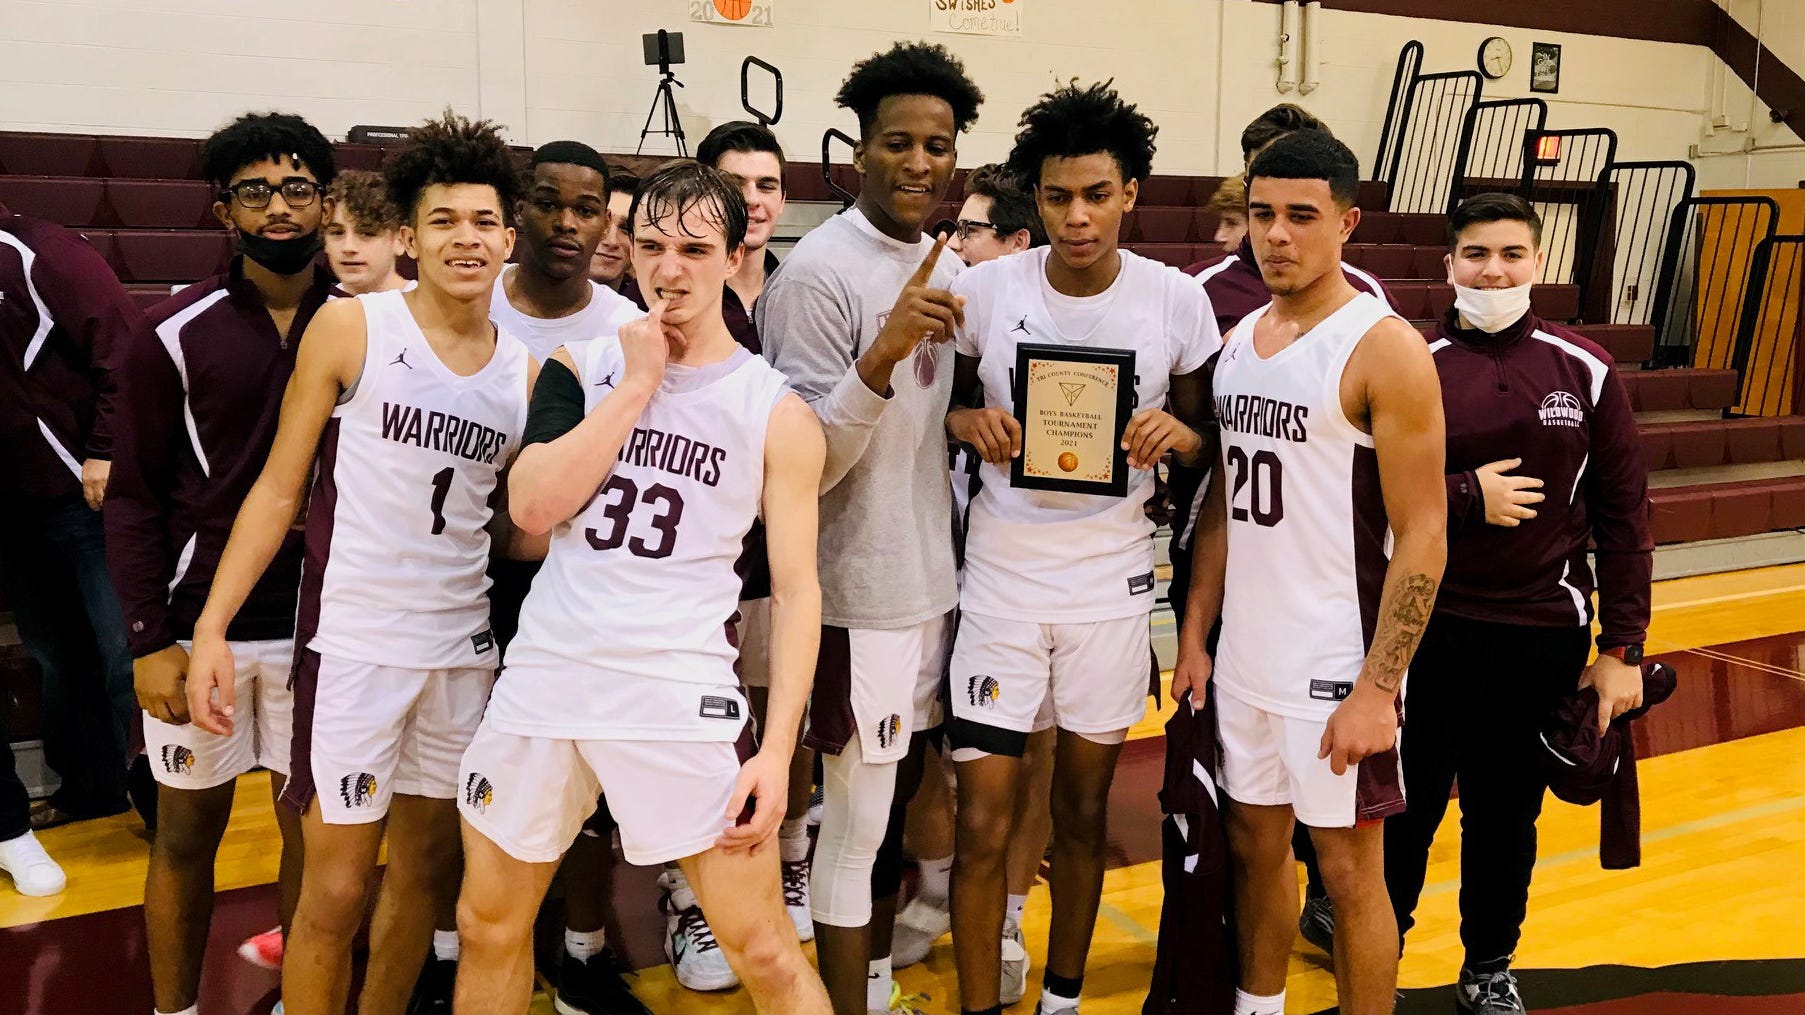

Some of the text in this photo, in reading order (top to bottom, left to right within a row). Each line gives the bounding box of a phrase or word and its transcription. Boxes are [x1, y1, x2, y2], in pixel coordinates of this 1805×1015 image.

[690, 1, 774, 26] 20 21
[1036, 370, 1109, 387] TRI COUNTY CONFERENCE
[1039, 409, 1103, 421] BOYS BASKETBALL
[1538, 407, 1583, 421] WILDWOOD
[1043, 419, 1098, 430] TOURNAMENT
[1543, 420, 1579, 428] BASKETBALL
[381, 401, 507, 464] WARRIORS
[1046, 429, 1094, 439] CHAMPIONS
[1060, 439, 1078, 447] 2021
[617, 427, 727, 487] RRIORS
[1227, 445, 1284, 527] 20
[430, 467, 455, 535] 1
[584, 473, 685, 559] 33
[1338, 687, 1347, 696] M
[730, 704, 735, 712] L
